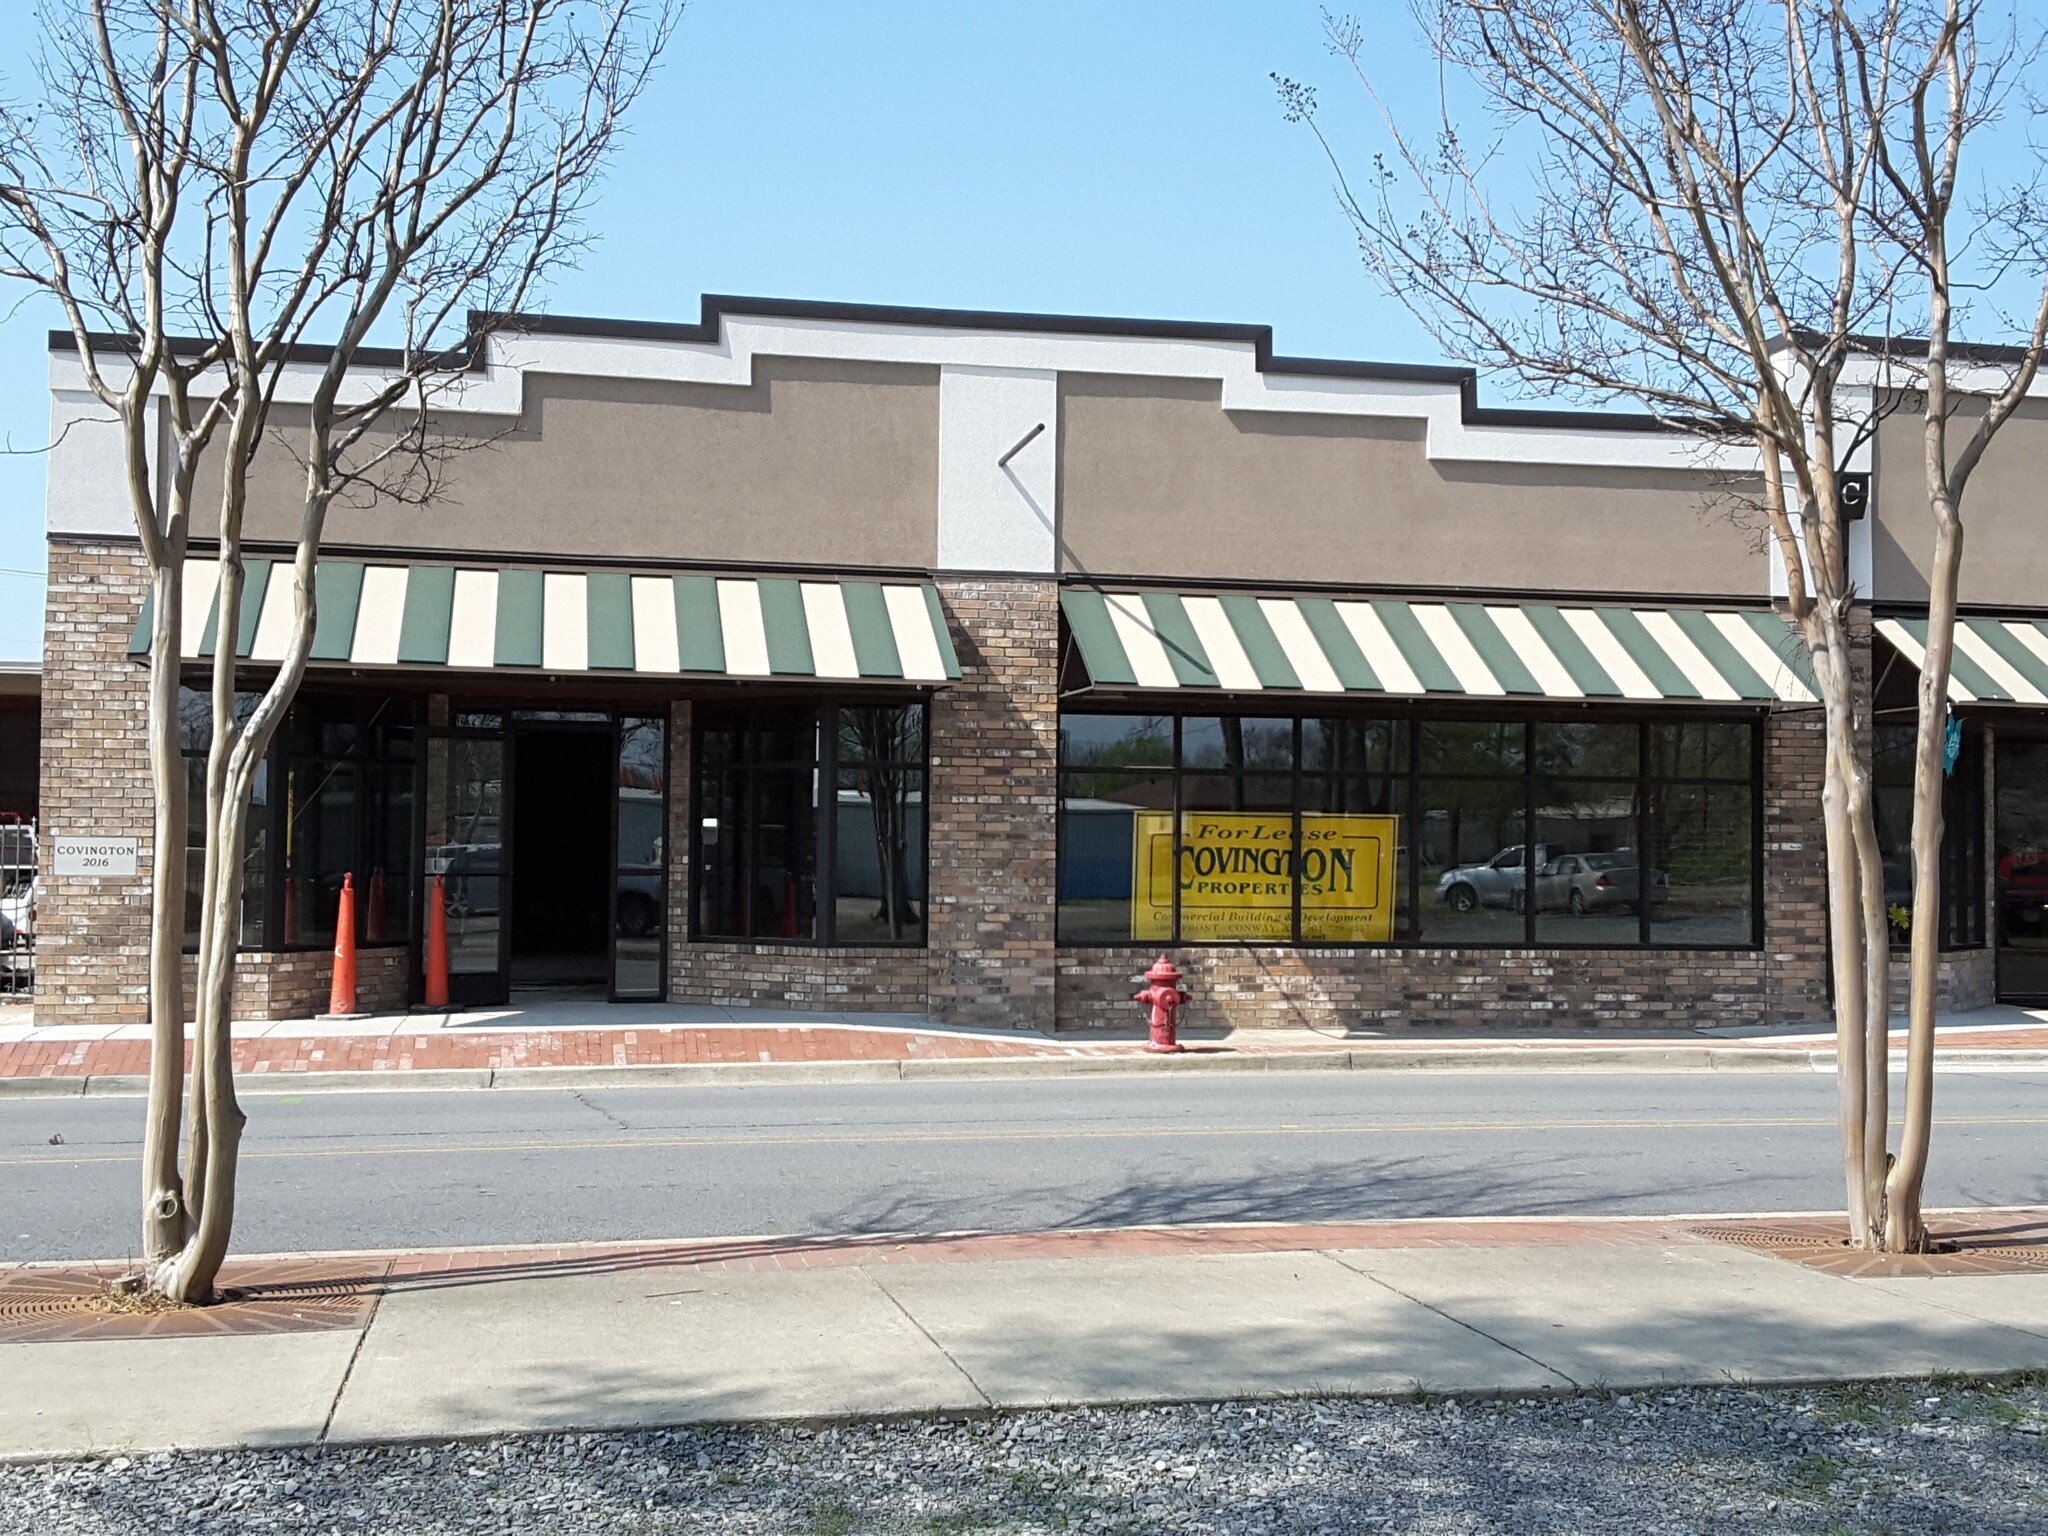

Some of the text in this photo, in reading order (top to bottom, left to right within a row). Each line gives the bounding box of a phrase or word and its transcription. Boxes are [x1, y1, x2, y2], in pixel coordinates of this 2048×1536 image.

[1196, 824, 1249, 840] For
[57, 846, 134, 855] COVINGTON
[82, 858, 109, 867] 2016
[1197, 882, 1323, 896] PROPERTES
[1229, 912, 1281, 923] Building
